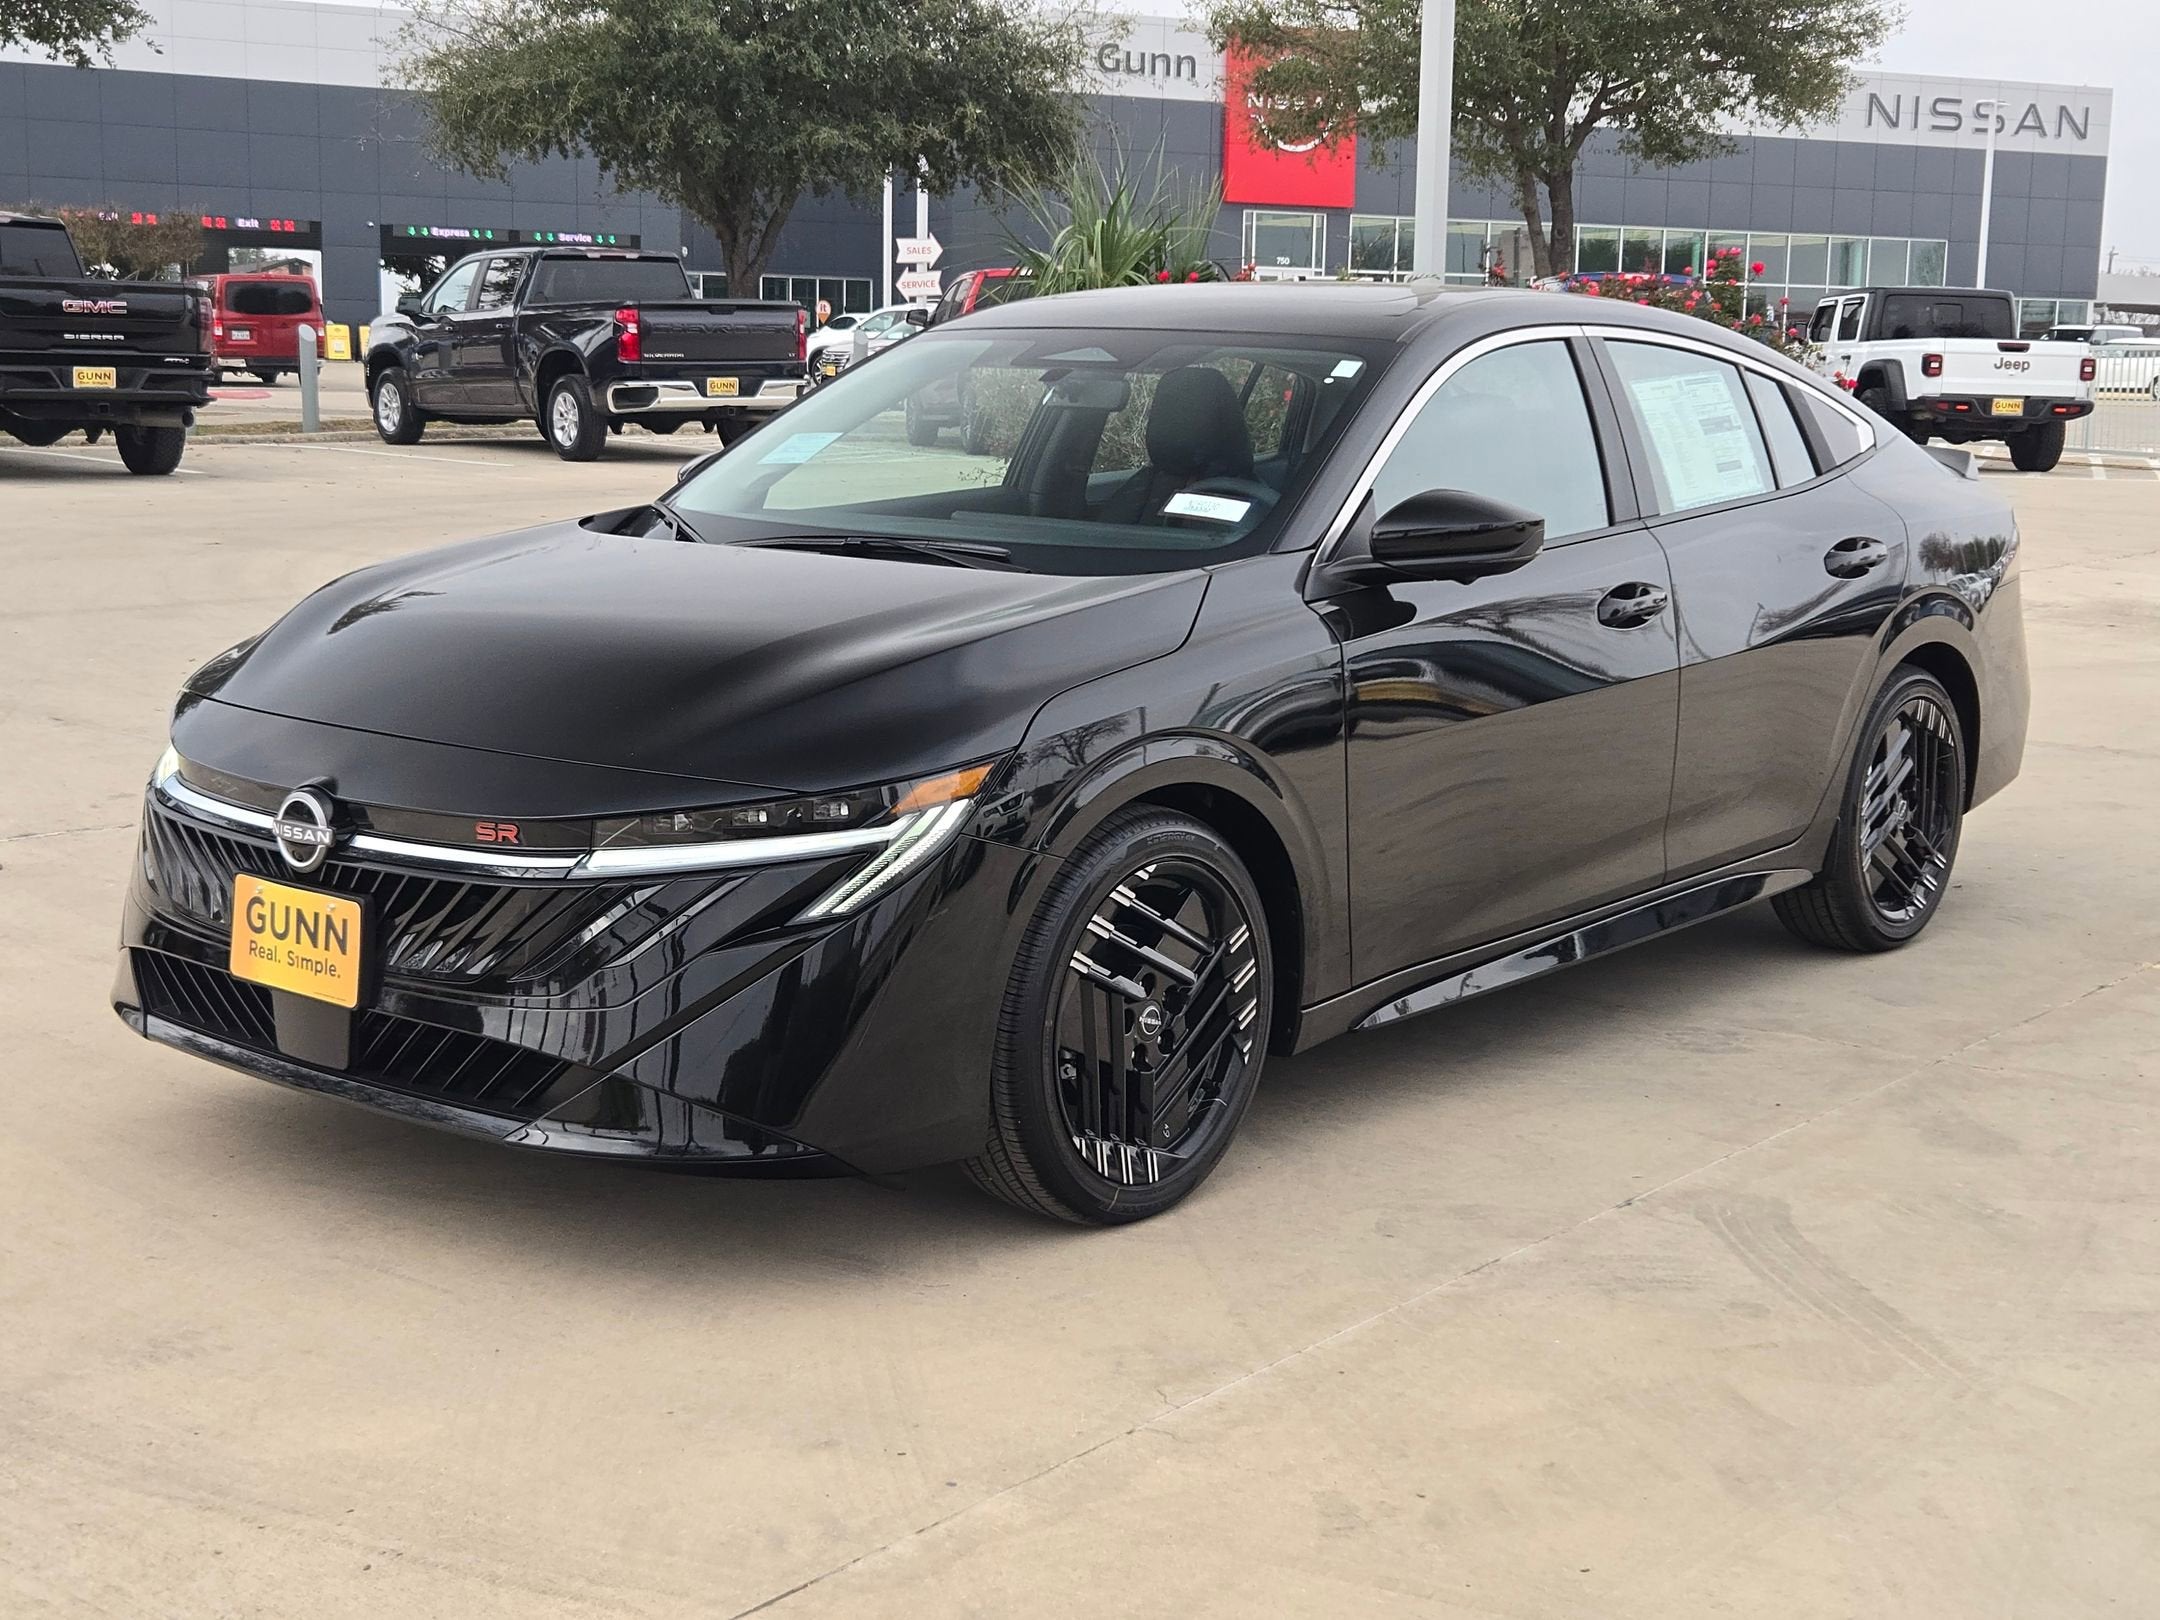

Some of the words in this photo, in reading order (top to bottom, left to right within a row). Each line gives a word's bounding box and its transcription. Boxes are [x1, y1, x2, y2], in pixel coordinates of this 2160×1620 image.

[1098, 43, 1196, 79] Gunn
[1866, 92, 2090, 141] NISSAN
[237, 218, 259, 229] Exit
[430, 226, 470, 238] Express
[558, 232, 592, 243] Service
[906, 246, 932, 255] SALES
[1276, 256, 1290, 265] 750
[901, 280, 936, 289] SERVICE
[62, 299, 128, 315] GMC
[63, 333, 125, 341] SIERRA
[1994, 357, 2031, 373] Jeep
[77, 371, 112, 381] GUNN
[709, 380, 736, 390] GUNN
[273, 820, 331, 845] NISSAN
[475, 821, 519, 844] SR
[246, 895, 348, 956] GUNN
[249, 939, 281, 964] Real.
